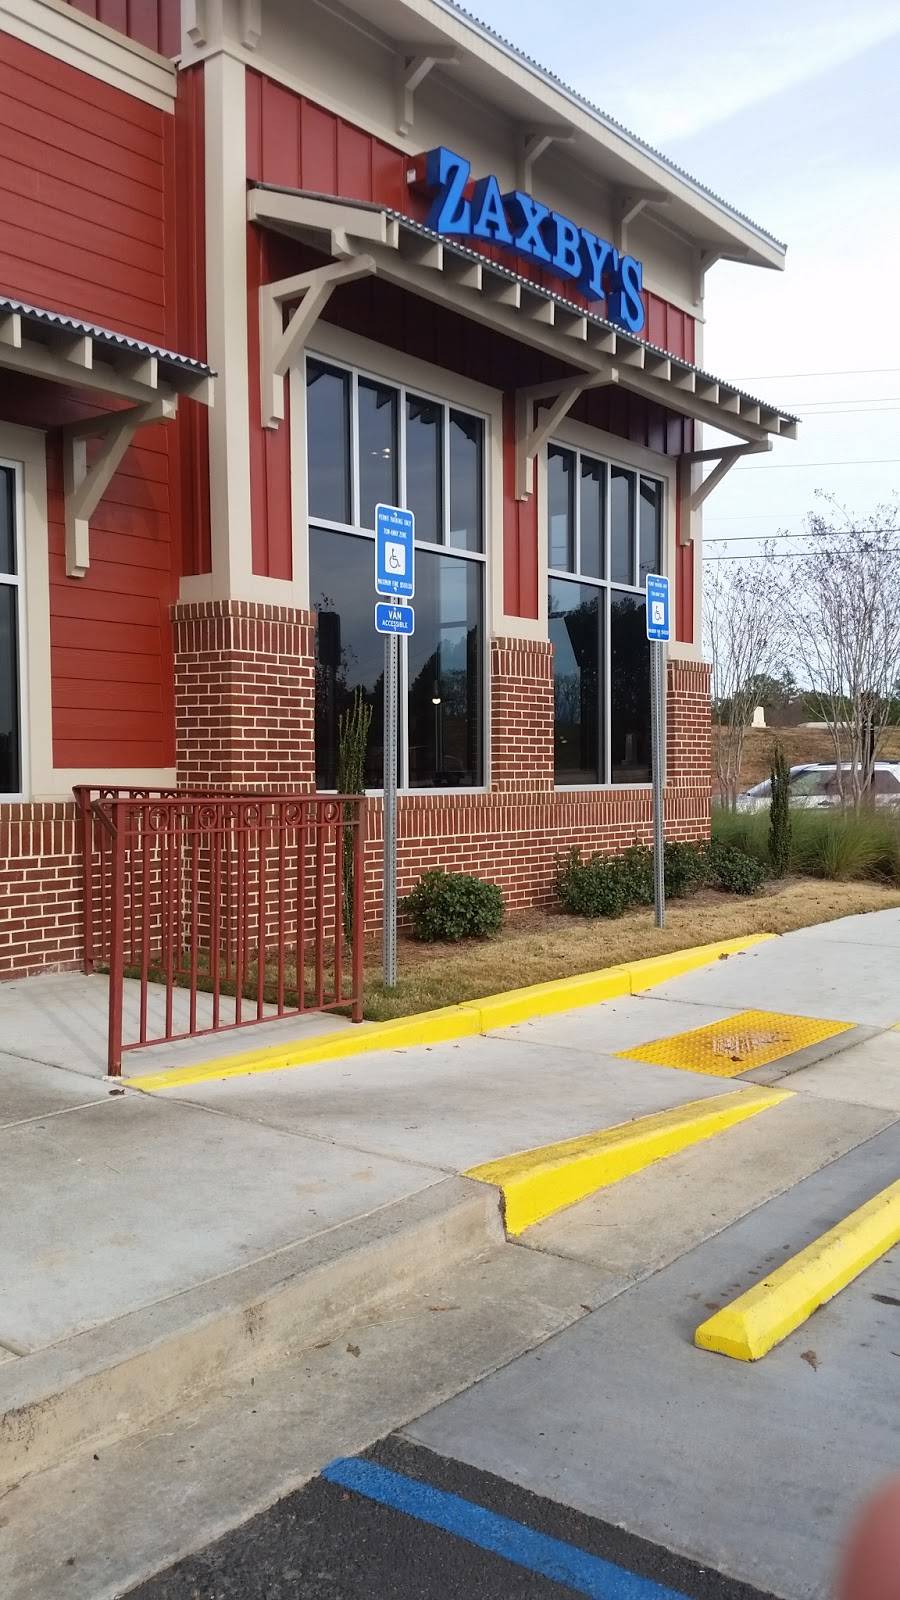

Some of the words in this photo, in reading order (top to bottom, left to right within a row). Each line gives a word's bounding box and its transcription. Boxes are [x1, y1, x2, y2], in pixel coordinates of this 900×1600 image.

[429, 146, 645, 333] ZAXBY'S
[388, 610, 402, 620] VAN
[382, 619, 408, 628] ACCESSIBLE
